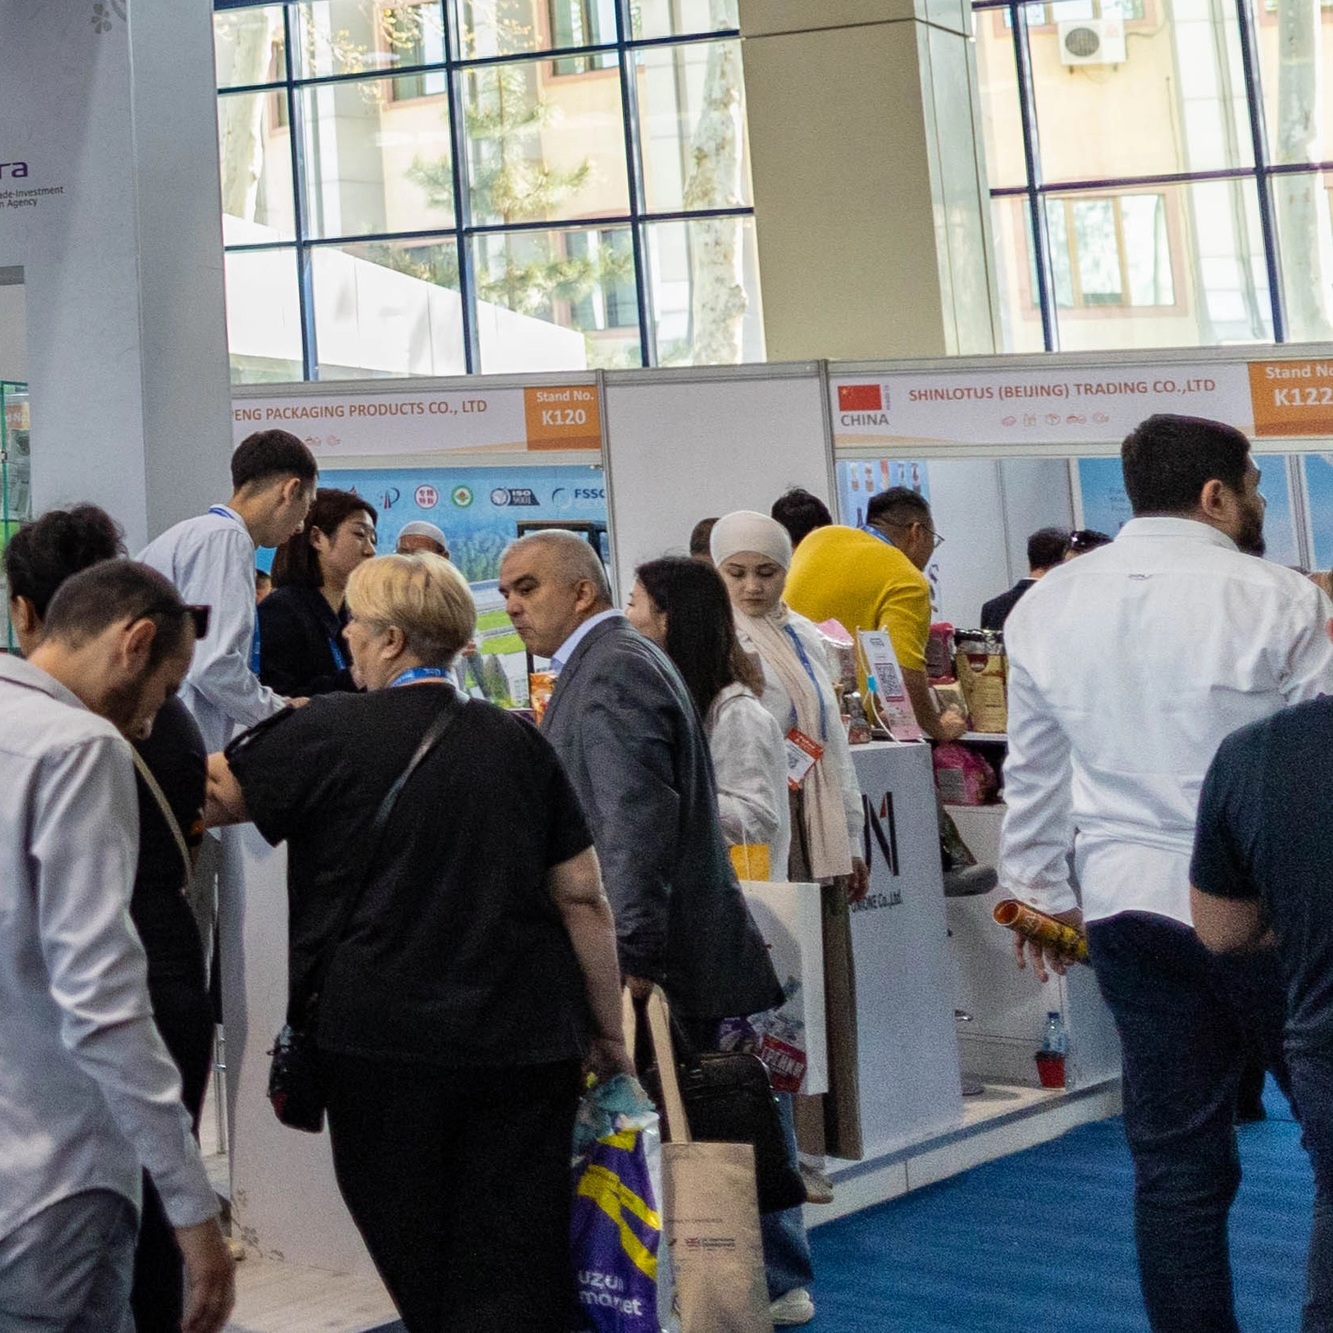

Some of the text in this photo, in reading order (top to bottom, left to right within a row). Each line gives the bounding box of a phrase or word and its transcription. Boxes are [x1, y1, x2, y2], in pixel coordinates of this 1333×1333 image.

[7, 197, 38, 209] Agency
[1265, 365, 1311, 379] Stand
[536, 388, 595, 402] Stand No.
[908, 386, 994, 402] SHINLOTUS
[998, 383, 1070, 401] (BEIJING)
[1074, 380, 1149, 396] TRADING
[1153, 378, 1216, 395] CO.,LTD
[1274, 386, 1333, 407] K122
[232, 398, 487, 422] ENG PACKAGING PRODUCTS CO., LTD
[541, 408, 587, 427] K120
[840, 413, 889, 427] CHINA
[578, 1270, 624, 1293] uzu
[578, 1290, 643, 1316] maret
